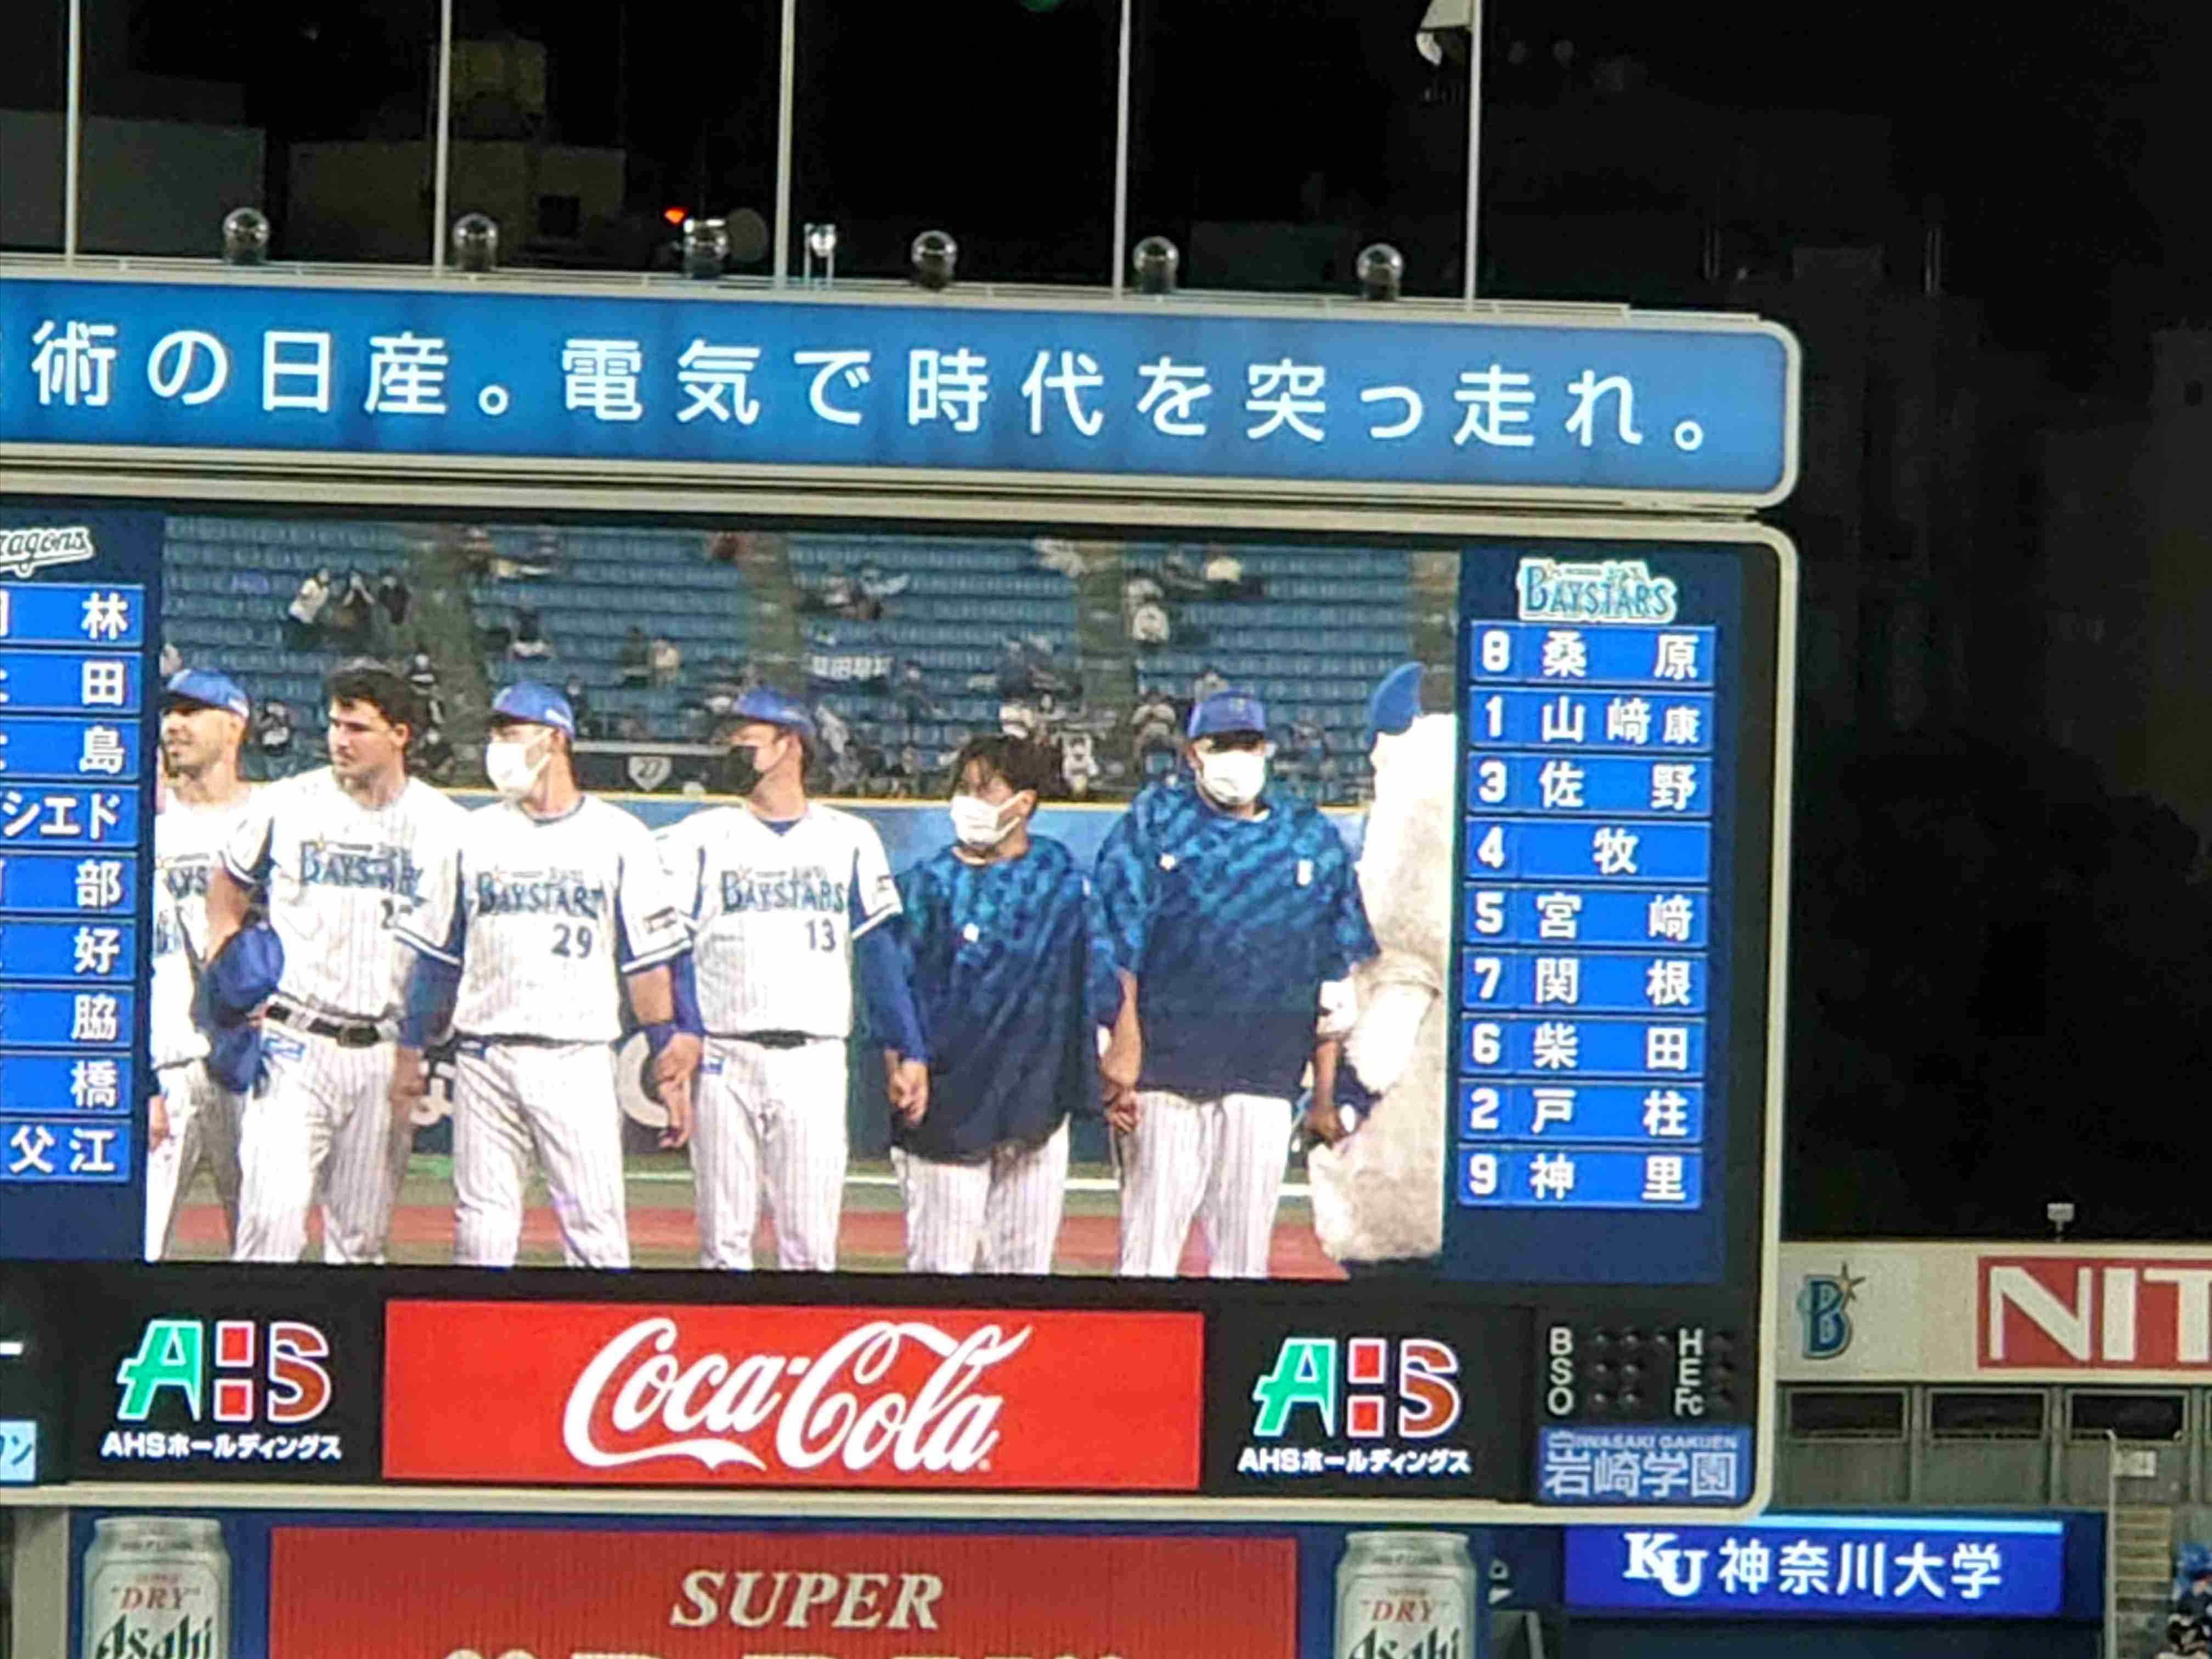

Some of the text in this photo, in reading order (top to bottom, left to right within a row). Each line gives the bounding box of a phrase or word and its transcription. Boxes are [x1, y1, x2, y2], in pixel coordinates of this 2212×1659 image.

[1482, 630, 1510, 672] 8
[1485, 696, 1503, 737] 1
[1479, 760, 1696, 810] 3 佐野
[1477, 826, 1639, 875] 4 牧
[804, 918, 837, 952] 13
[1475, 891, 1504, 934] 5
[550, 923, 594, 959] 29
[1474, 957, 1691, 1006] 7 関根
[1472, 1022, 1688, 1070] 6 柴田
[1470, 1087, 1688, 1136] 2 戸柱
[9, 1125, 116, 1173] 父江
[1469, 1153, 1686, 1201] 9 神里
[563, 1317, 1032, 1473] Coca-Cola
[101, 1430, 343, 1460] AHSホールディングス
[1236, 1446, 1472, 1474] AHSホールディングス
[1544, 1431, 1738, 1498] 岩崎学園
[1718, 1537, 2002, 1599] 神奈川大学
[121, 1587, 184, 1610] DRY
[669, 1570, 943, 1630] SUPER
